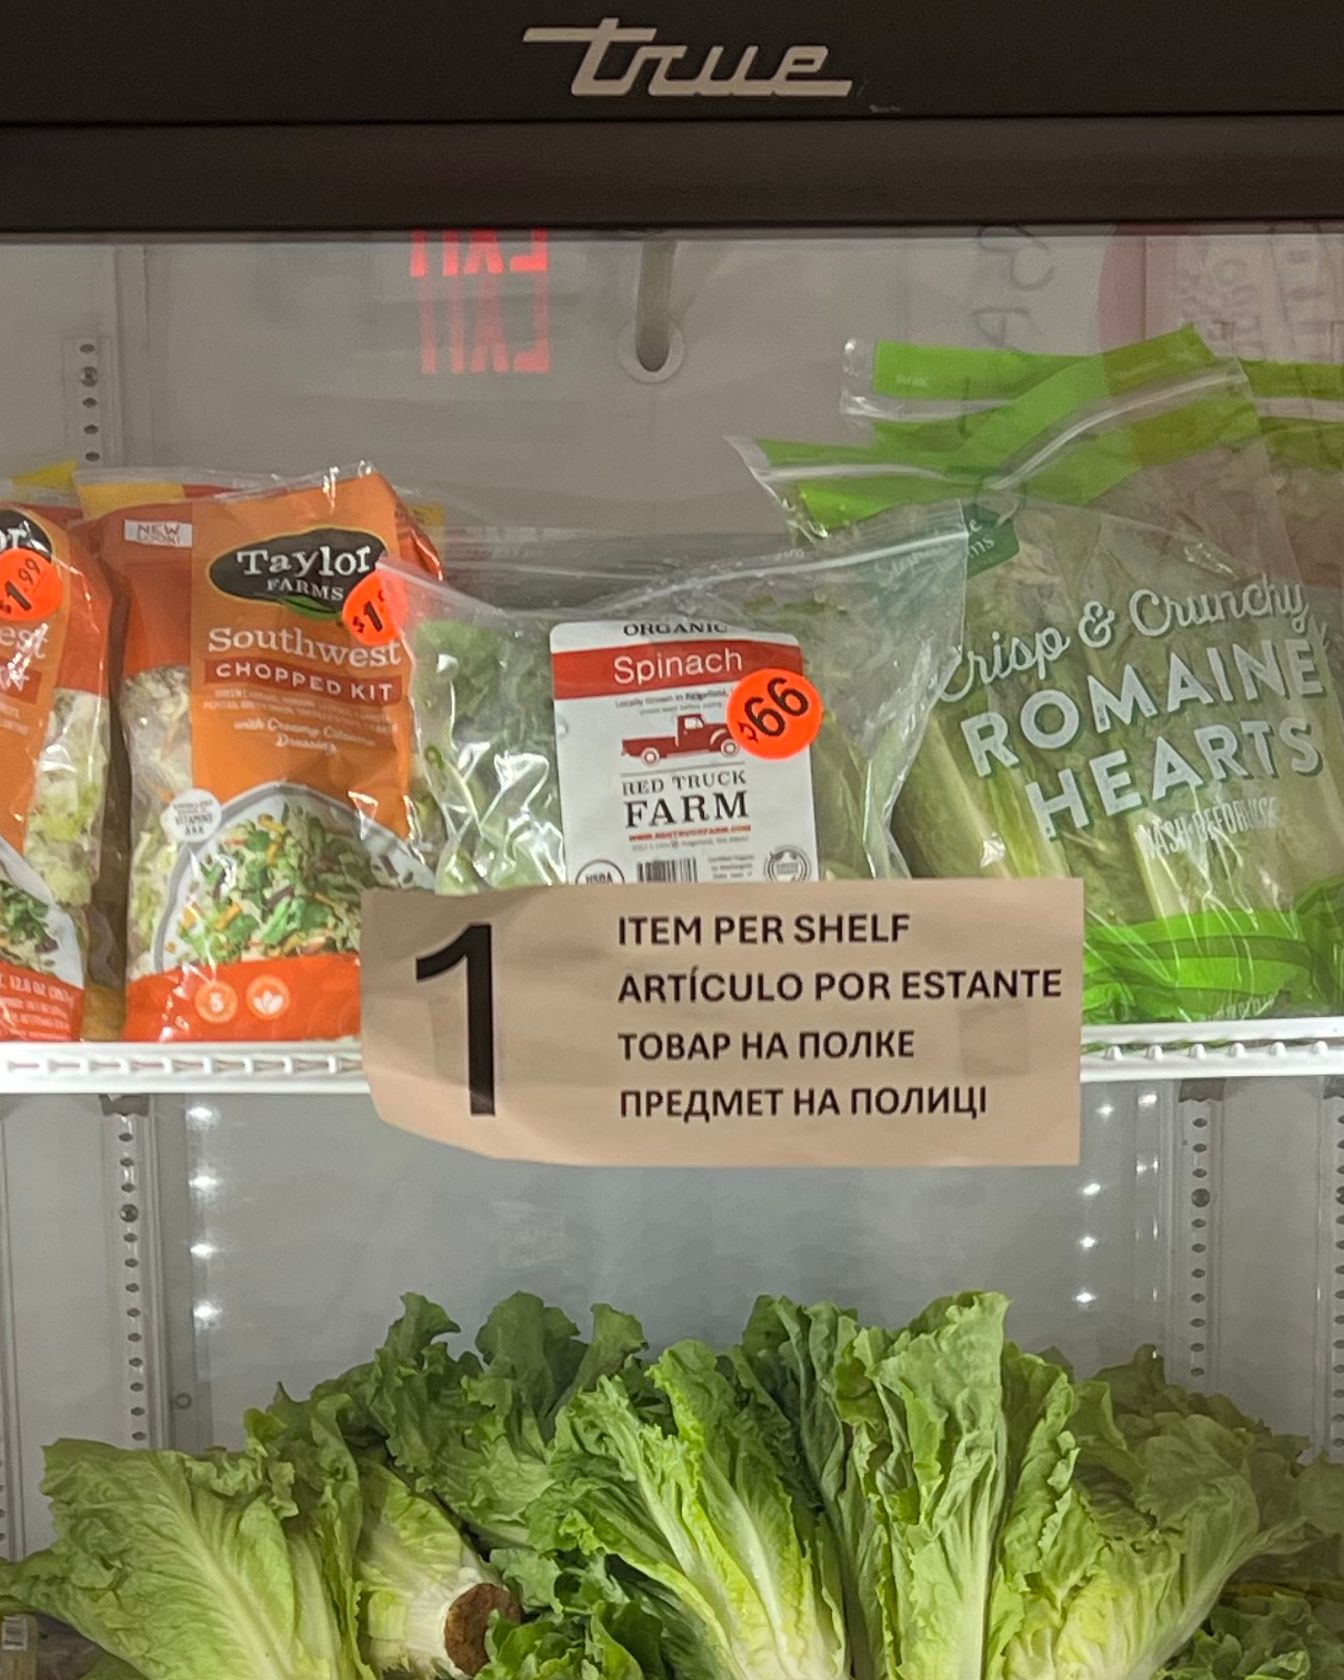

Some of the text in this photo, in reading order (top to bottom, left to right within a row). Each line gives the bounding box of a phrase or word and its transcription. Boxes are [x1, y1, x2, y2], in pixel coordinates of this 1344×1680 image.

[523, 17, 853, 97] true
[137, 523, 181, 536] NEW
[237, 545, 371, 585] Taylor
[266, 578, 345, 600] FARMS
[623, 622, 728, 636] ORGANIC
[1078, 600, 1116, 648] &
[1129, 573, 1311, 637] Crunchy
[208, 627, 402, 668] Southwest
[613, 648, 743, 685] Spinach
[215, 661, 393, 701] CHOPPED KIT
[960, 637, 1328, 780] ROMAINE
[621, 769, 747, 796] RED TRUCK
[1024, 716, 1326, 842] HEARTS
[624, 790, 750, 829] FARM
[617, 913, 911, 946] ITEM PER SHELF
[617, 967, 1063, 1003] ARTÍCULO POR ESTANTE
[414, 921, 497, 1118] 1
[618, 1029, 915, 1061] ТОВАР НА ПОЛКЕ
[620, 1087, 784, 1123] ПРЕДМЕТ
[793, 1087, 841, 1115] НА
